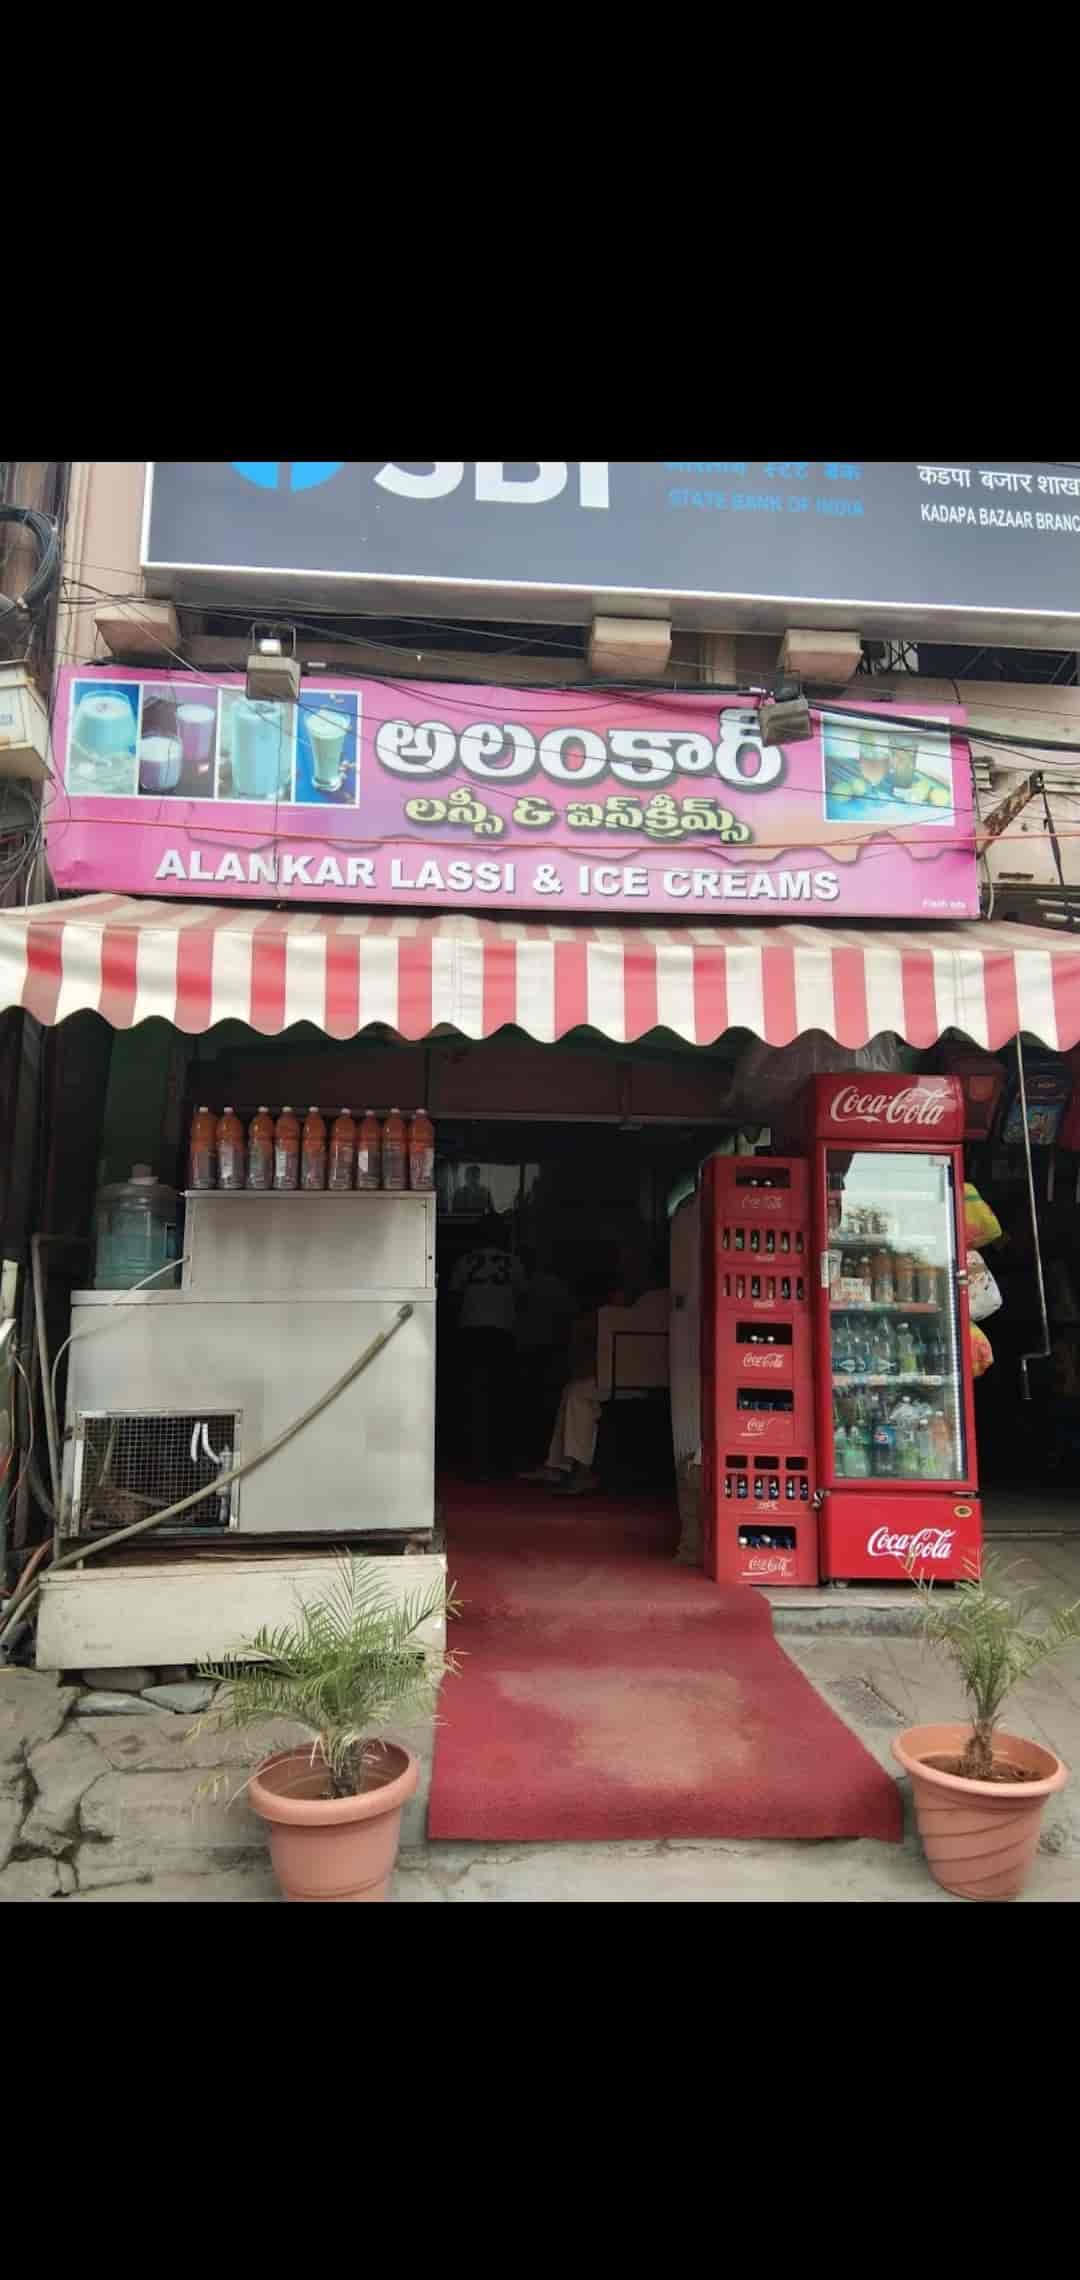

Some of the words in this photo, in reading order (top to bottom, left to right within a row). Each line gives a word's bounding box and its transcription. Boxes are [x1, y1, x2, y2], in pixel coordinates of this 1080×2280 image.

[978, 470, 1032, 494] बजार
[920, 503, 976, 525] KADAPA
[979, 508, 1033, 529] BAZAAR
[375, 707, 783, 786] అలంకార్
[513, 796, 556, 825] &
[155, 849, 377, 889] ALANKAR
[390, 857, 515, 892] LASSI
[532, 865, 563, 896] &
[578, 864, 649, 898] ICE
[662, 868, 840, 902] CREAMS
[831, 1085, 951, 1125] Coca-Cola
[466, 1255, 511, 1285] 23
[866, 1525, 957, 1559] Coca-Cola
